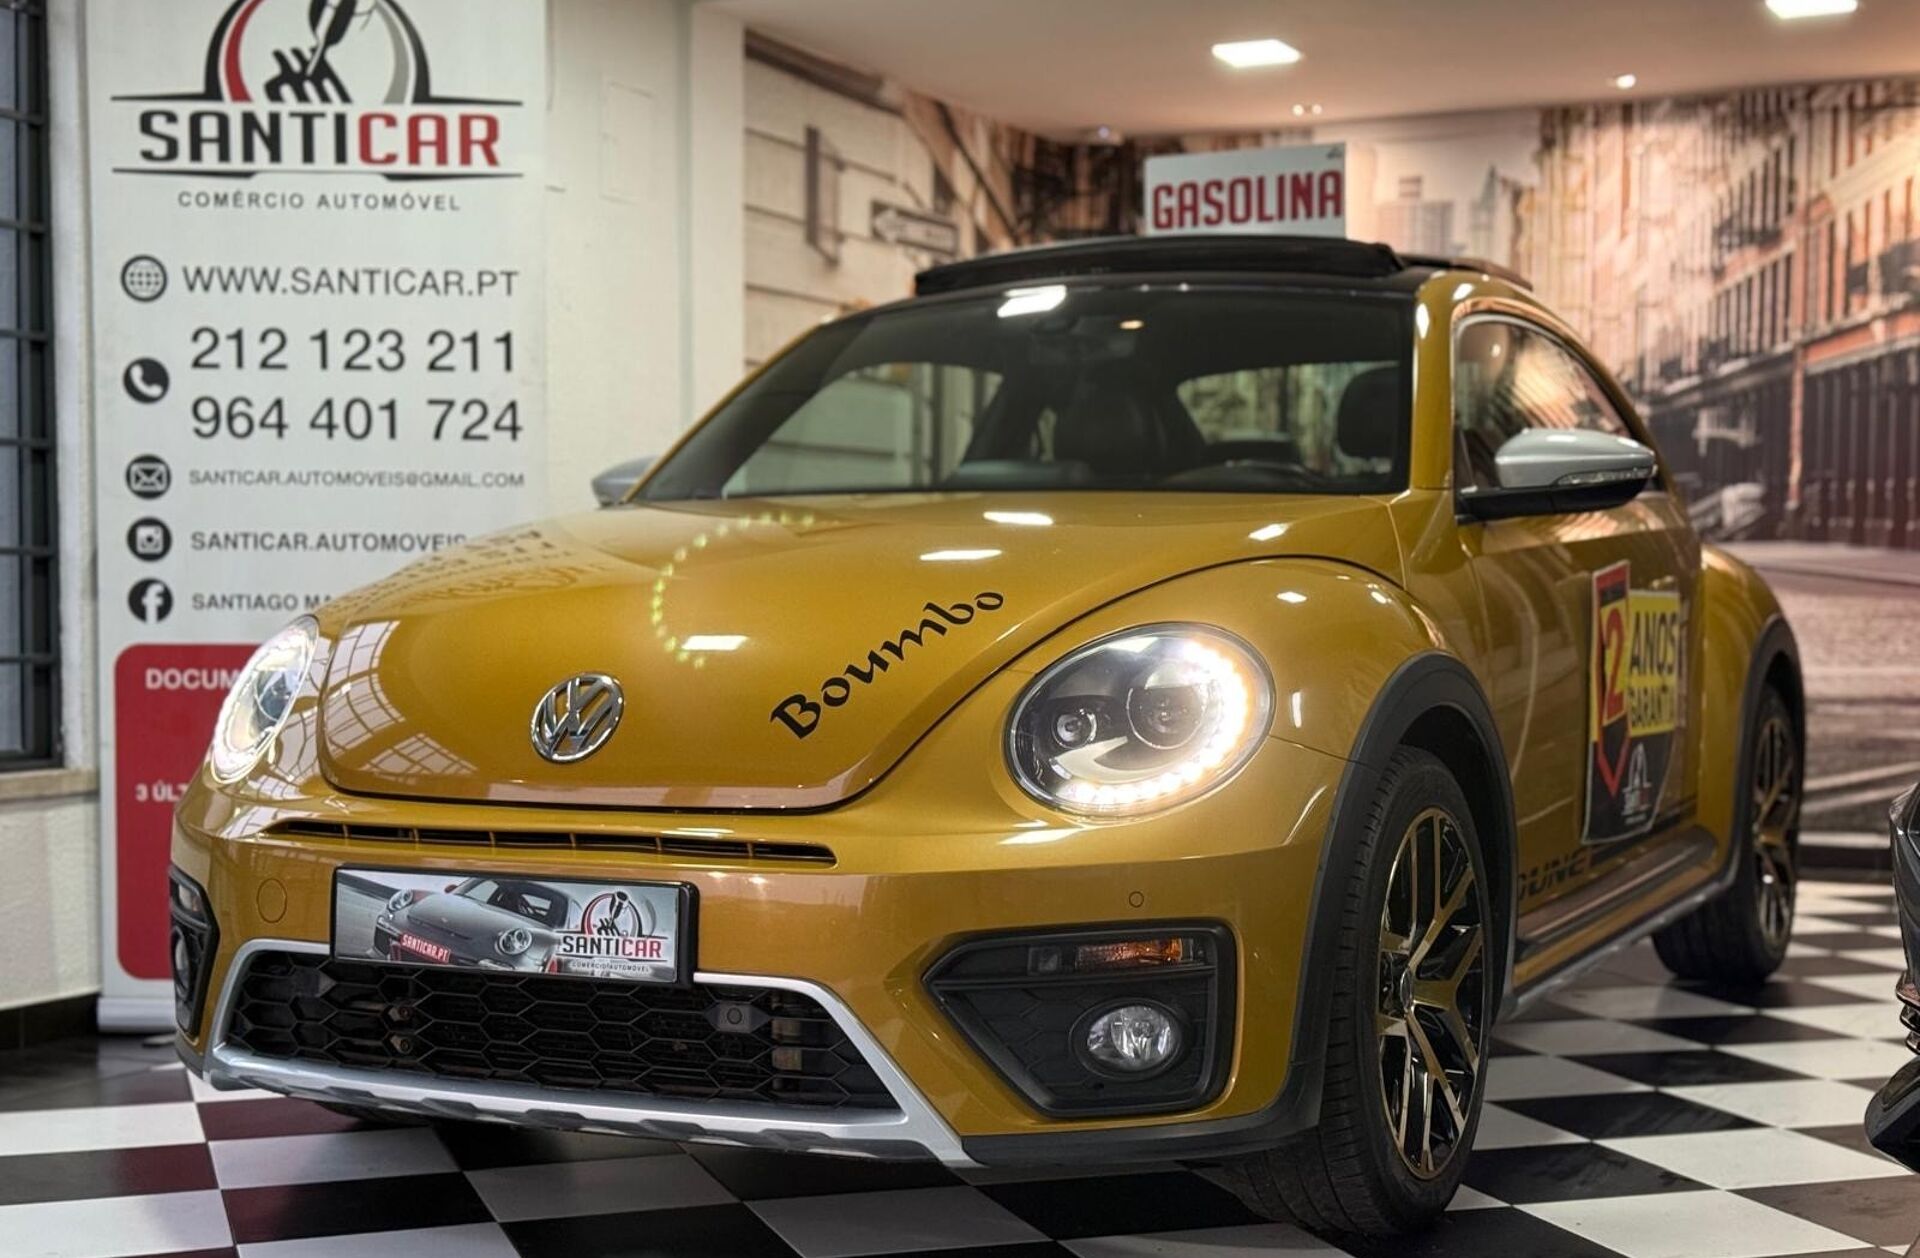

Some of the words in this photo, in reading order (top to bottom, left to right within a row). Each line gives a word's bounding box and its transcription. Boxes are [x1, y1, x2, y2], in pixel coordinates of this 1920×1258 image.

[139, 110, 500, 166] SANTICAR
[178, 189, 304, 209] COMÉRCIO
[317, 190, 461, 212] AUTOMÓVEL
[1153, 170, 1342, 230] GASOLINA
[182, 265, 520, 297] WWW.SANTICAR.PT
[191, 326, 288, 370] 212
[309, 329, 406, 372] 123
[427, 329, 515, 373] 211
[191, 396, 289, 440] 964
[309, 397, 398, 441] 401
[427, 399, 522, 442] 724
[188, 469, 525, 489] SANTICAR.AUTOMOVEIS@GMAIL.COM
[191, 593, 298, 611] SANTIAGO
[770, 591, 1004, 740] Boumbo
[135, 783, 148, 802] 3
[402, 934, 449, 962] SANTICAR.PT
[562, 935, 662, 958] SANTICAR
